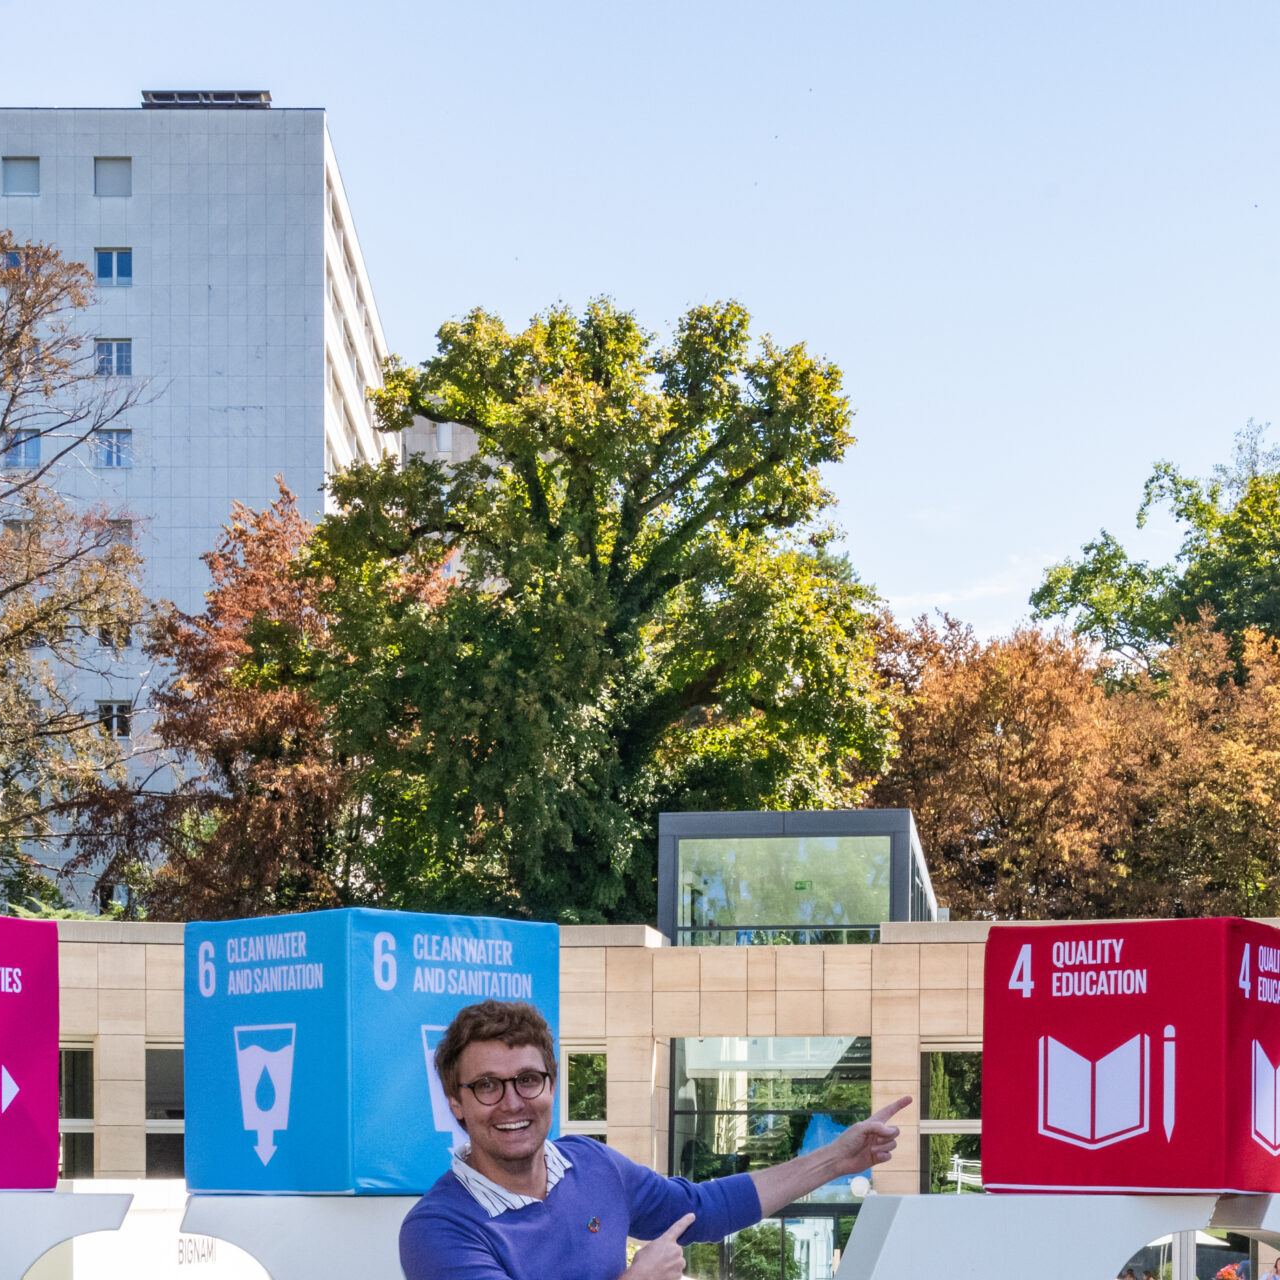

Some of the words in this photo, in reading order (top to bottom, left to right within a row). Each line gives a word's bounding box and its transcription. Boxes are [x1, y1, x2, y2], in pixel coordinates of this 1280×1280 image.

[227, 936, 264, 963] CLEAN
[265, 931, 306, 960] WATER
[373, 932, 397, 991] 6
[413, 934, 462, 962] CLEAN
[462, 937, 513, 966] WATER
[1053, 939, 1123, 968] QUALITY
[198, 941, 216, 997] 6
[228, 969, 253, 996] AND
[254, 963, 323, 994] SANITATION
[414, 967, 445, 993] AND
[447, 968, 531, 998] SANITATION
[1009, 944, 1034, 997] 4
[1052, 969, 1146, 996] EDUCATION
[1239, 943, 1251, 998] 4
[178, 1238, 216, 1265] BIGNAMI
